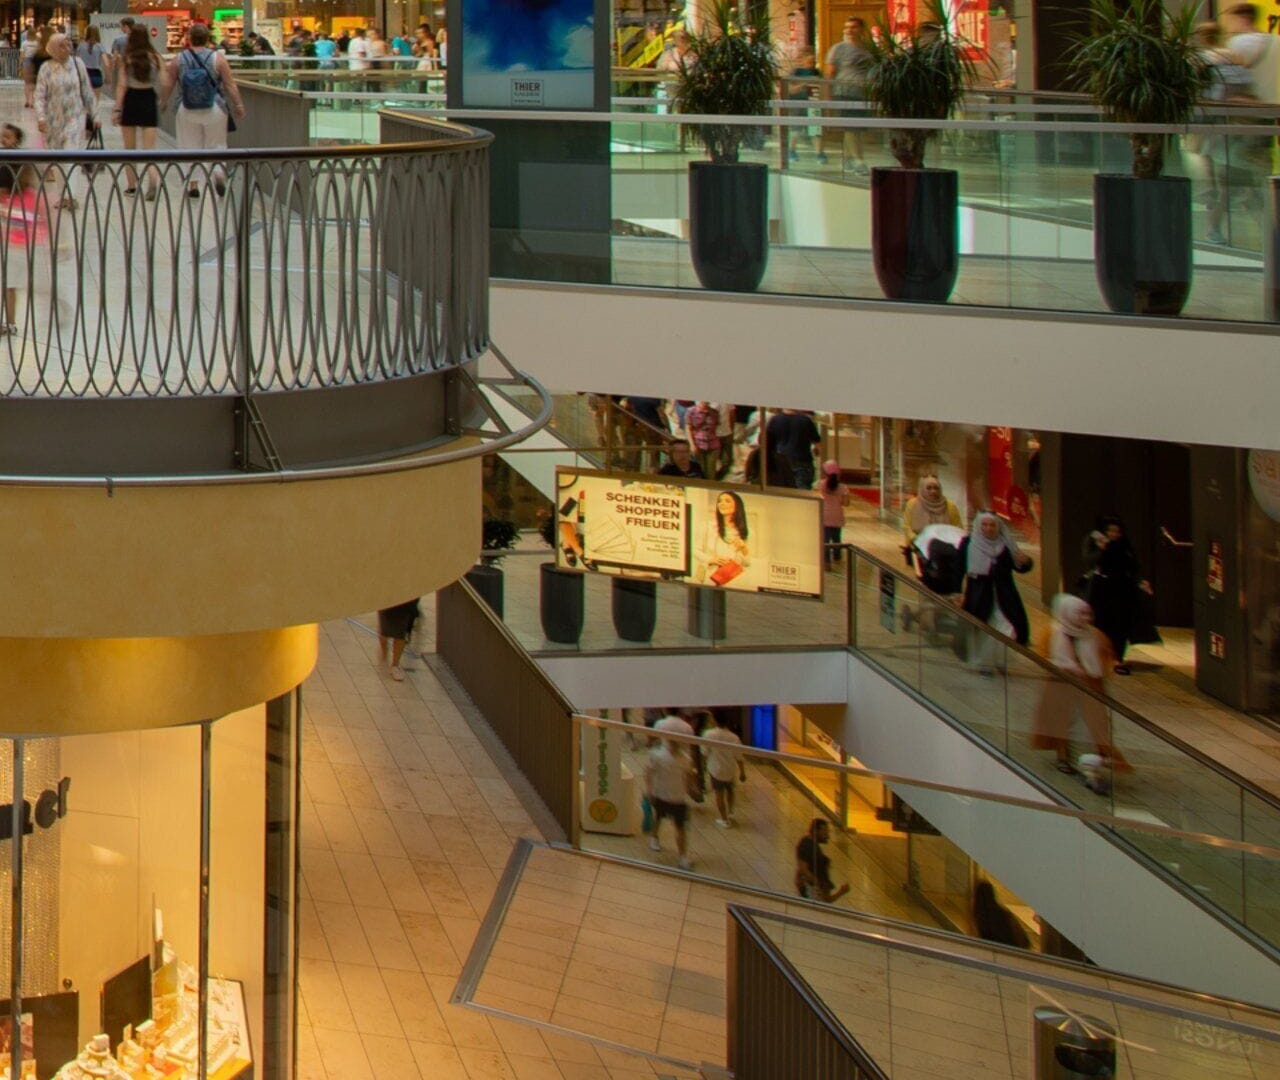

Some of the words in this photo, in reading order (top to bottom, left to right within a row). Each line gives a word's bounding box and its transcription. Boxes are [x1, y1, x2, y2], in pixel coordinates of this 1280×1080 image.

[605, 491, 680, 508] SCHENKEN
[615, 504, 680, 520] SHOPPEN
[625, 516, 680, 532] FREUEN
[771, 565, 797, 576] THIER
